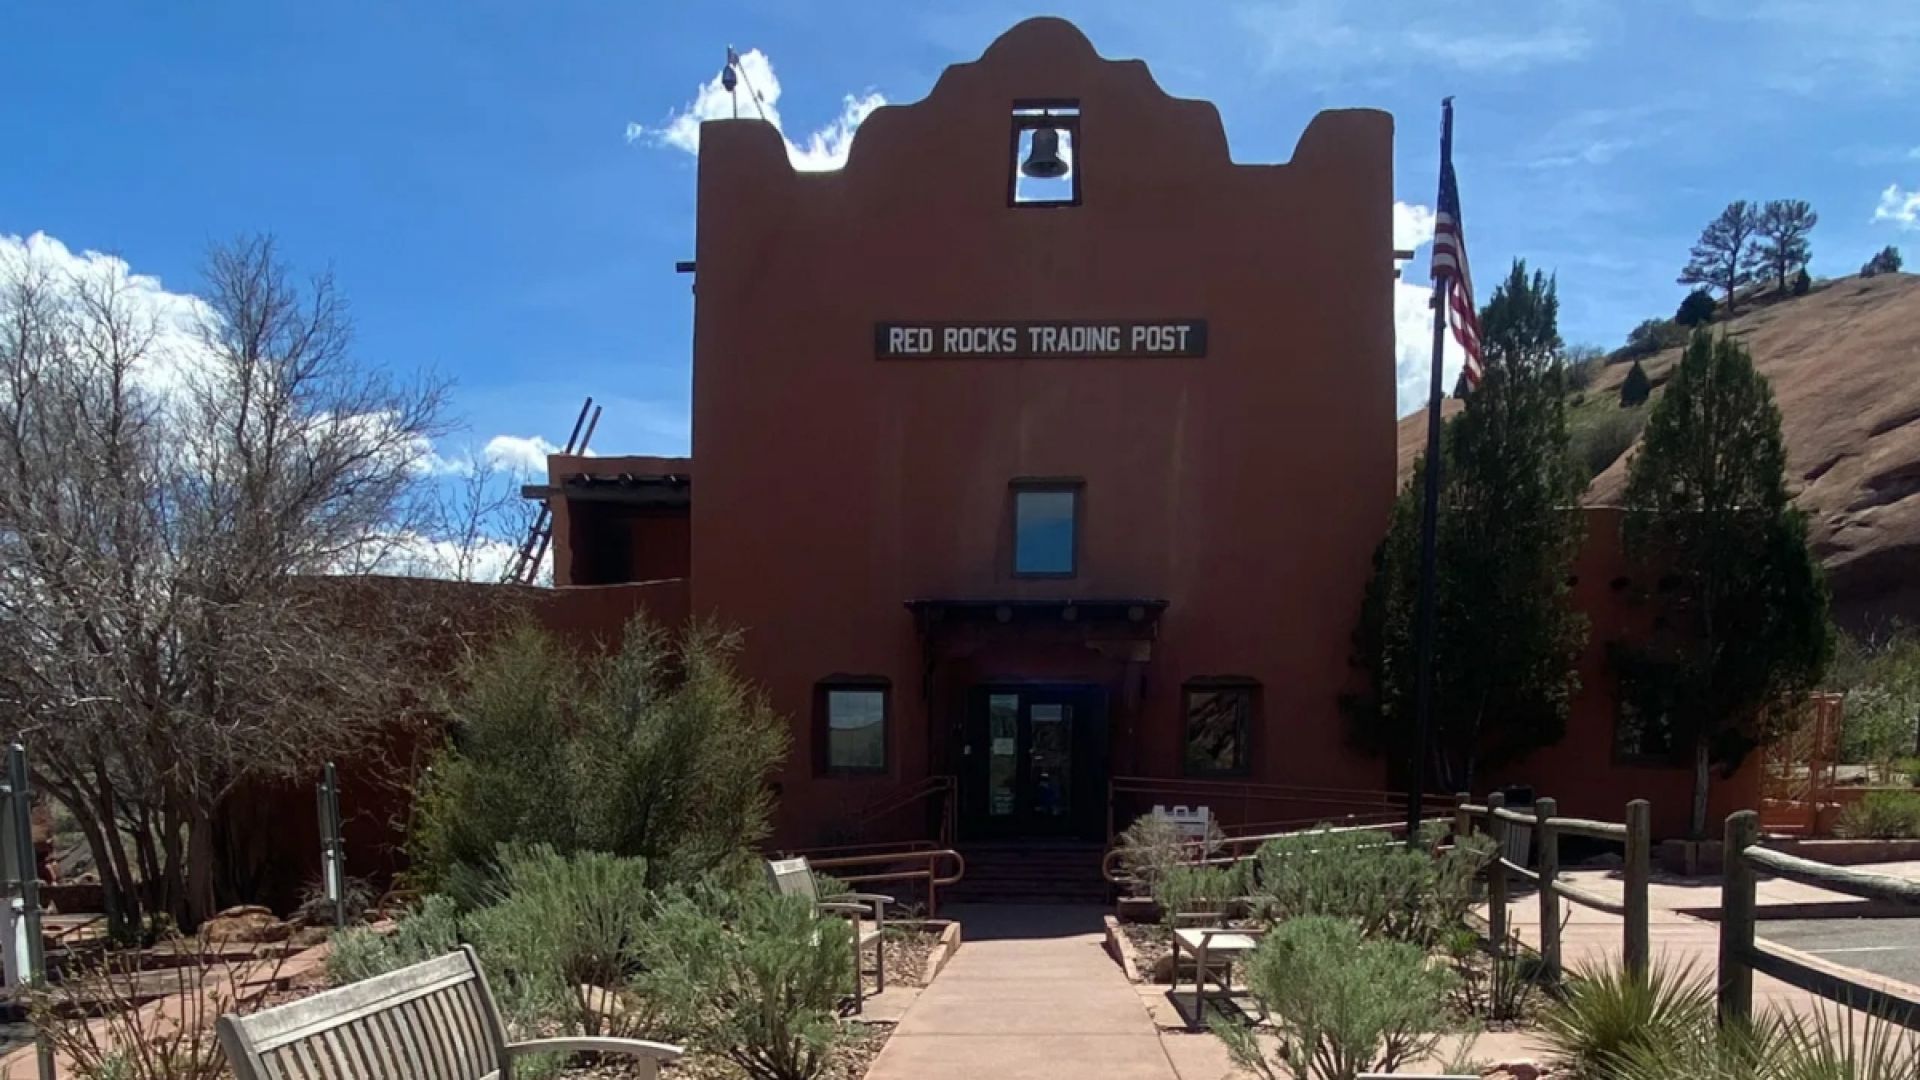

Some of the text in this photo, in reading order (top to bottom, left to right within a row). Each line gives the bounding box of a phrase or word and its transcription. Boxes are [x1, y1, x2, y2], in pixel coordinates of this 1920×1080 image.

[889, 325, 1190, 353] RED ROCKS TRADING POST
